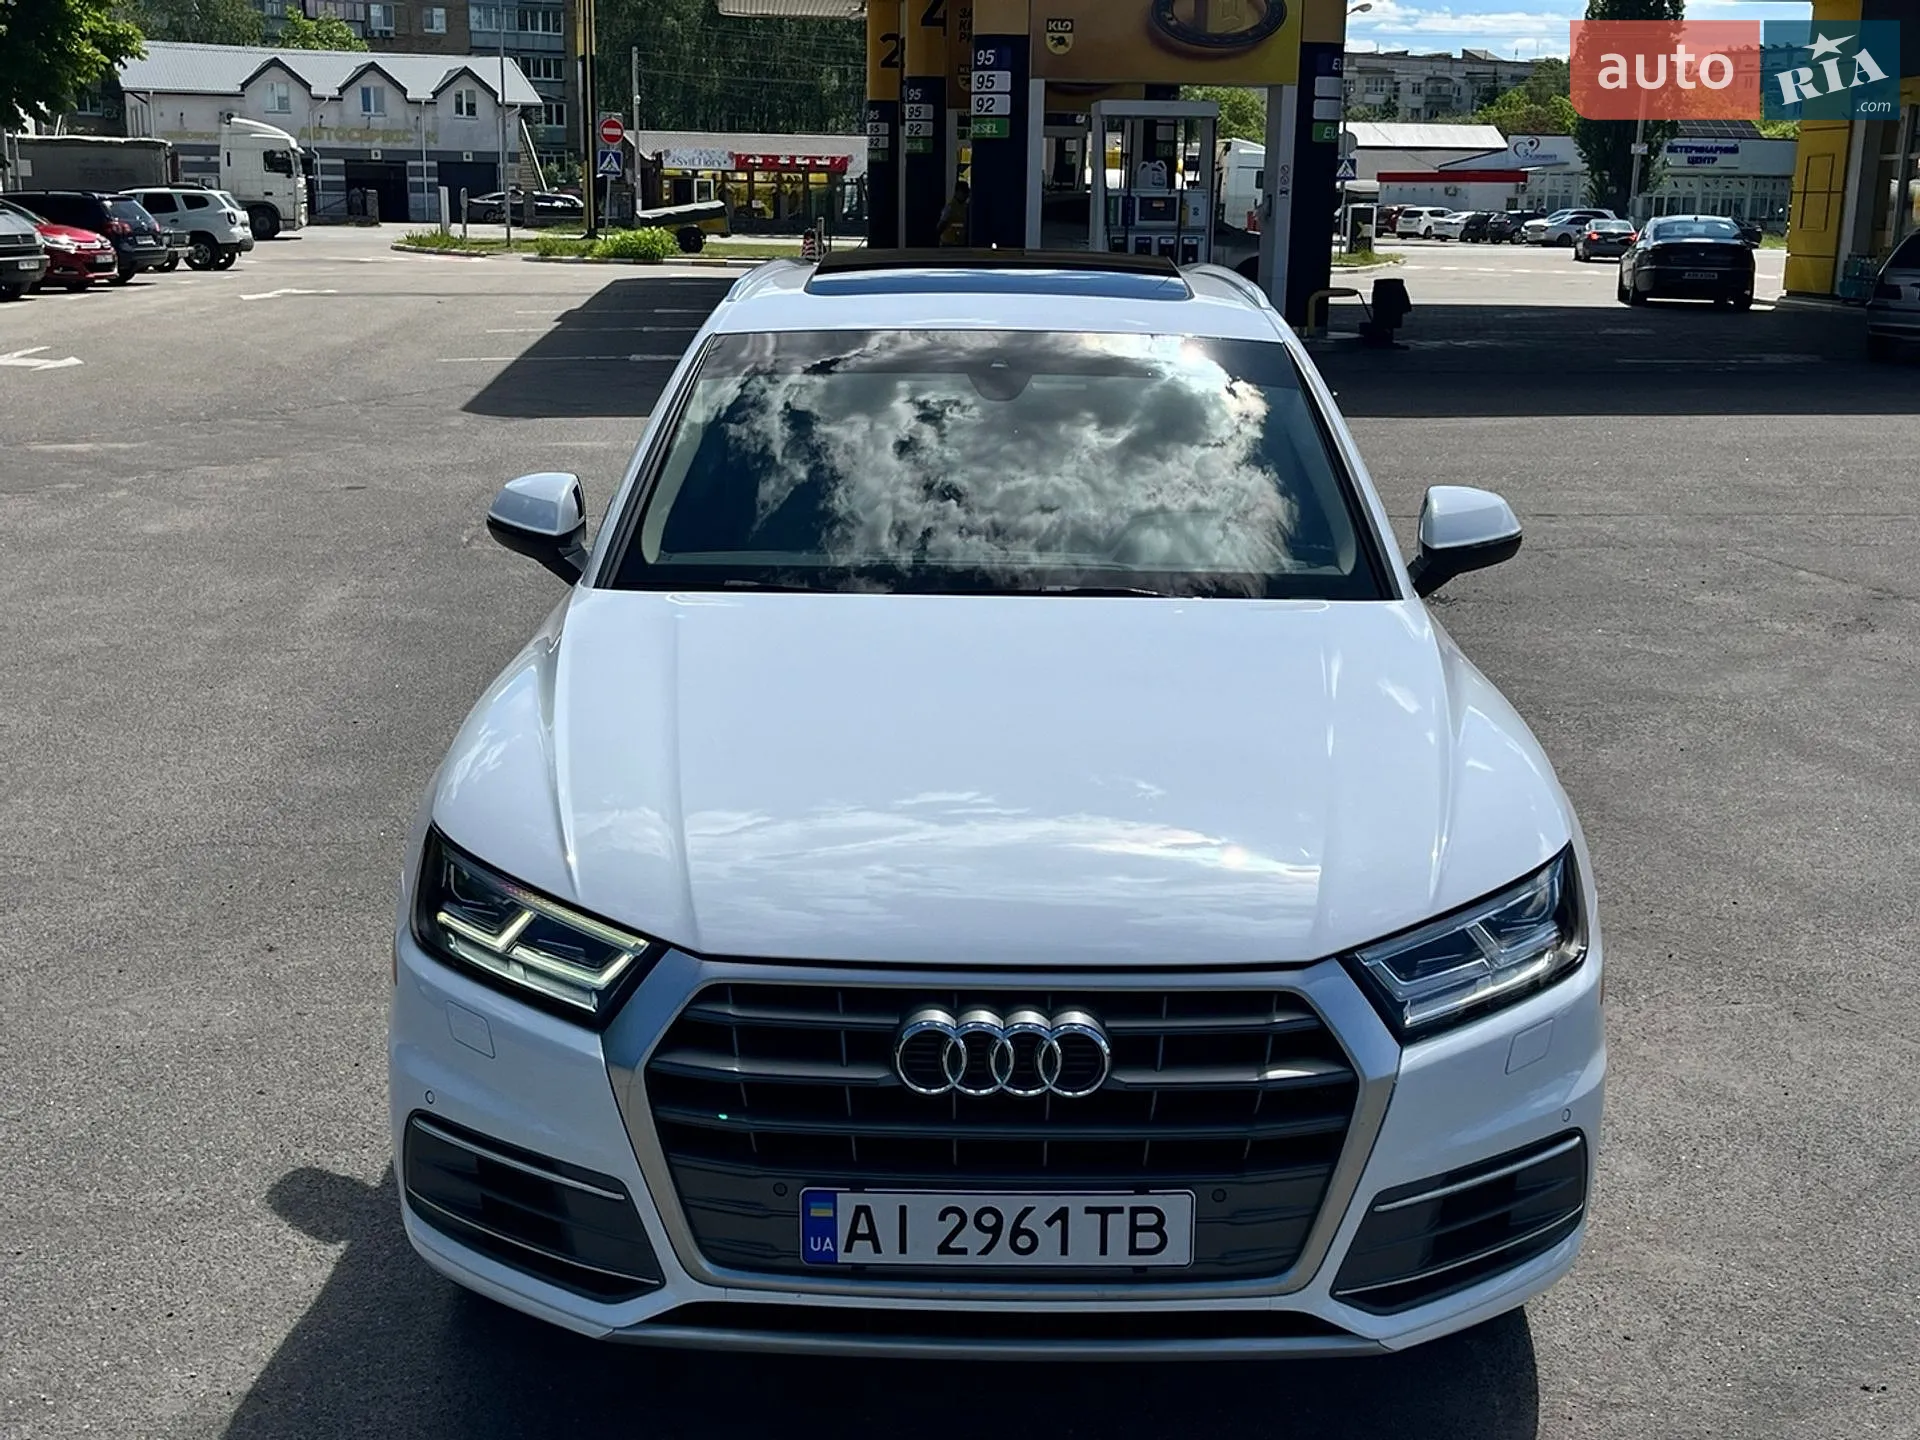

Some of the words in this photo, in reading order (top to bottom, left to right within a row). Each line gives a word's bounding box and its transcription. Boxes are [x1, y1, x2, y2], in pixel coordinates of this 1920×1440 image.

[1047, 20, 1073, 32] KLO
[976, 48, 997, 66] 95
[976, 73, 996, 90] 95
[976, 97, 996, 113] 92
[908, 106, 922, 118] 95
[908, 123, 922, 135] 92
[1687, 156, 1718, 165] ЦЕНТР
[810, 1236, 834, 1251] UA
